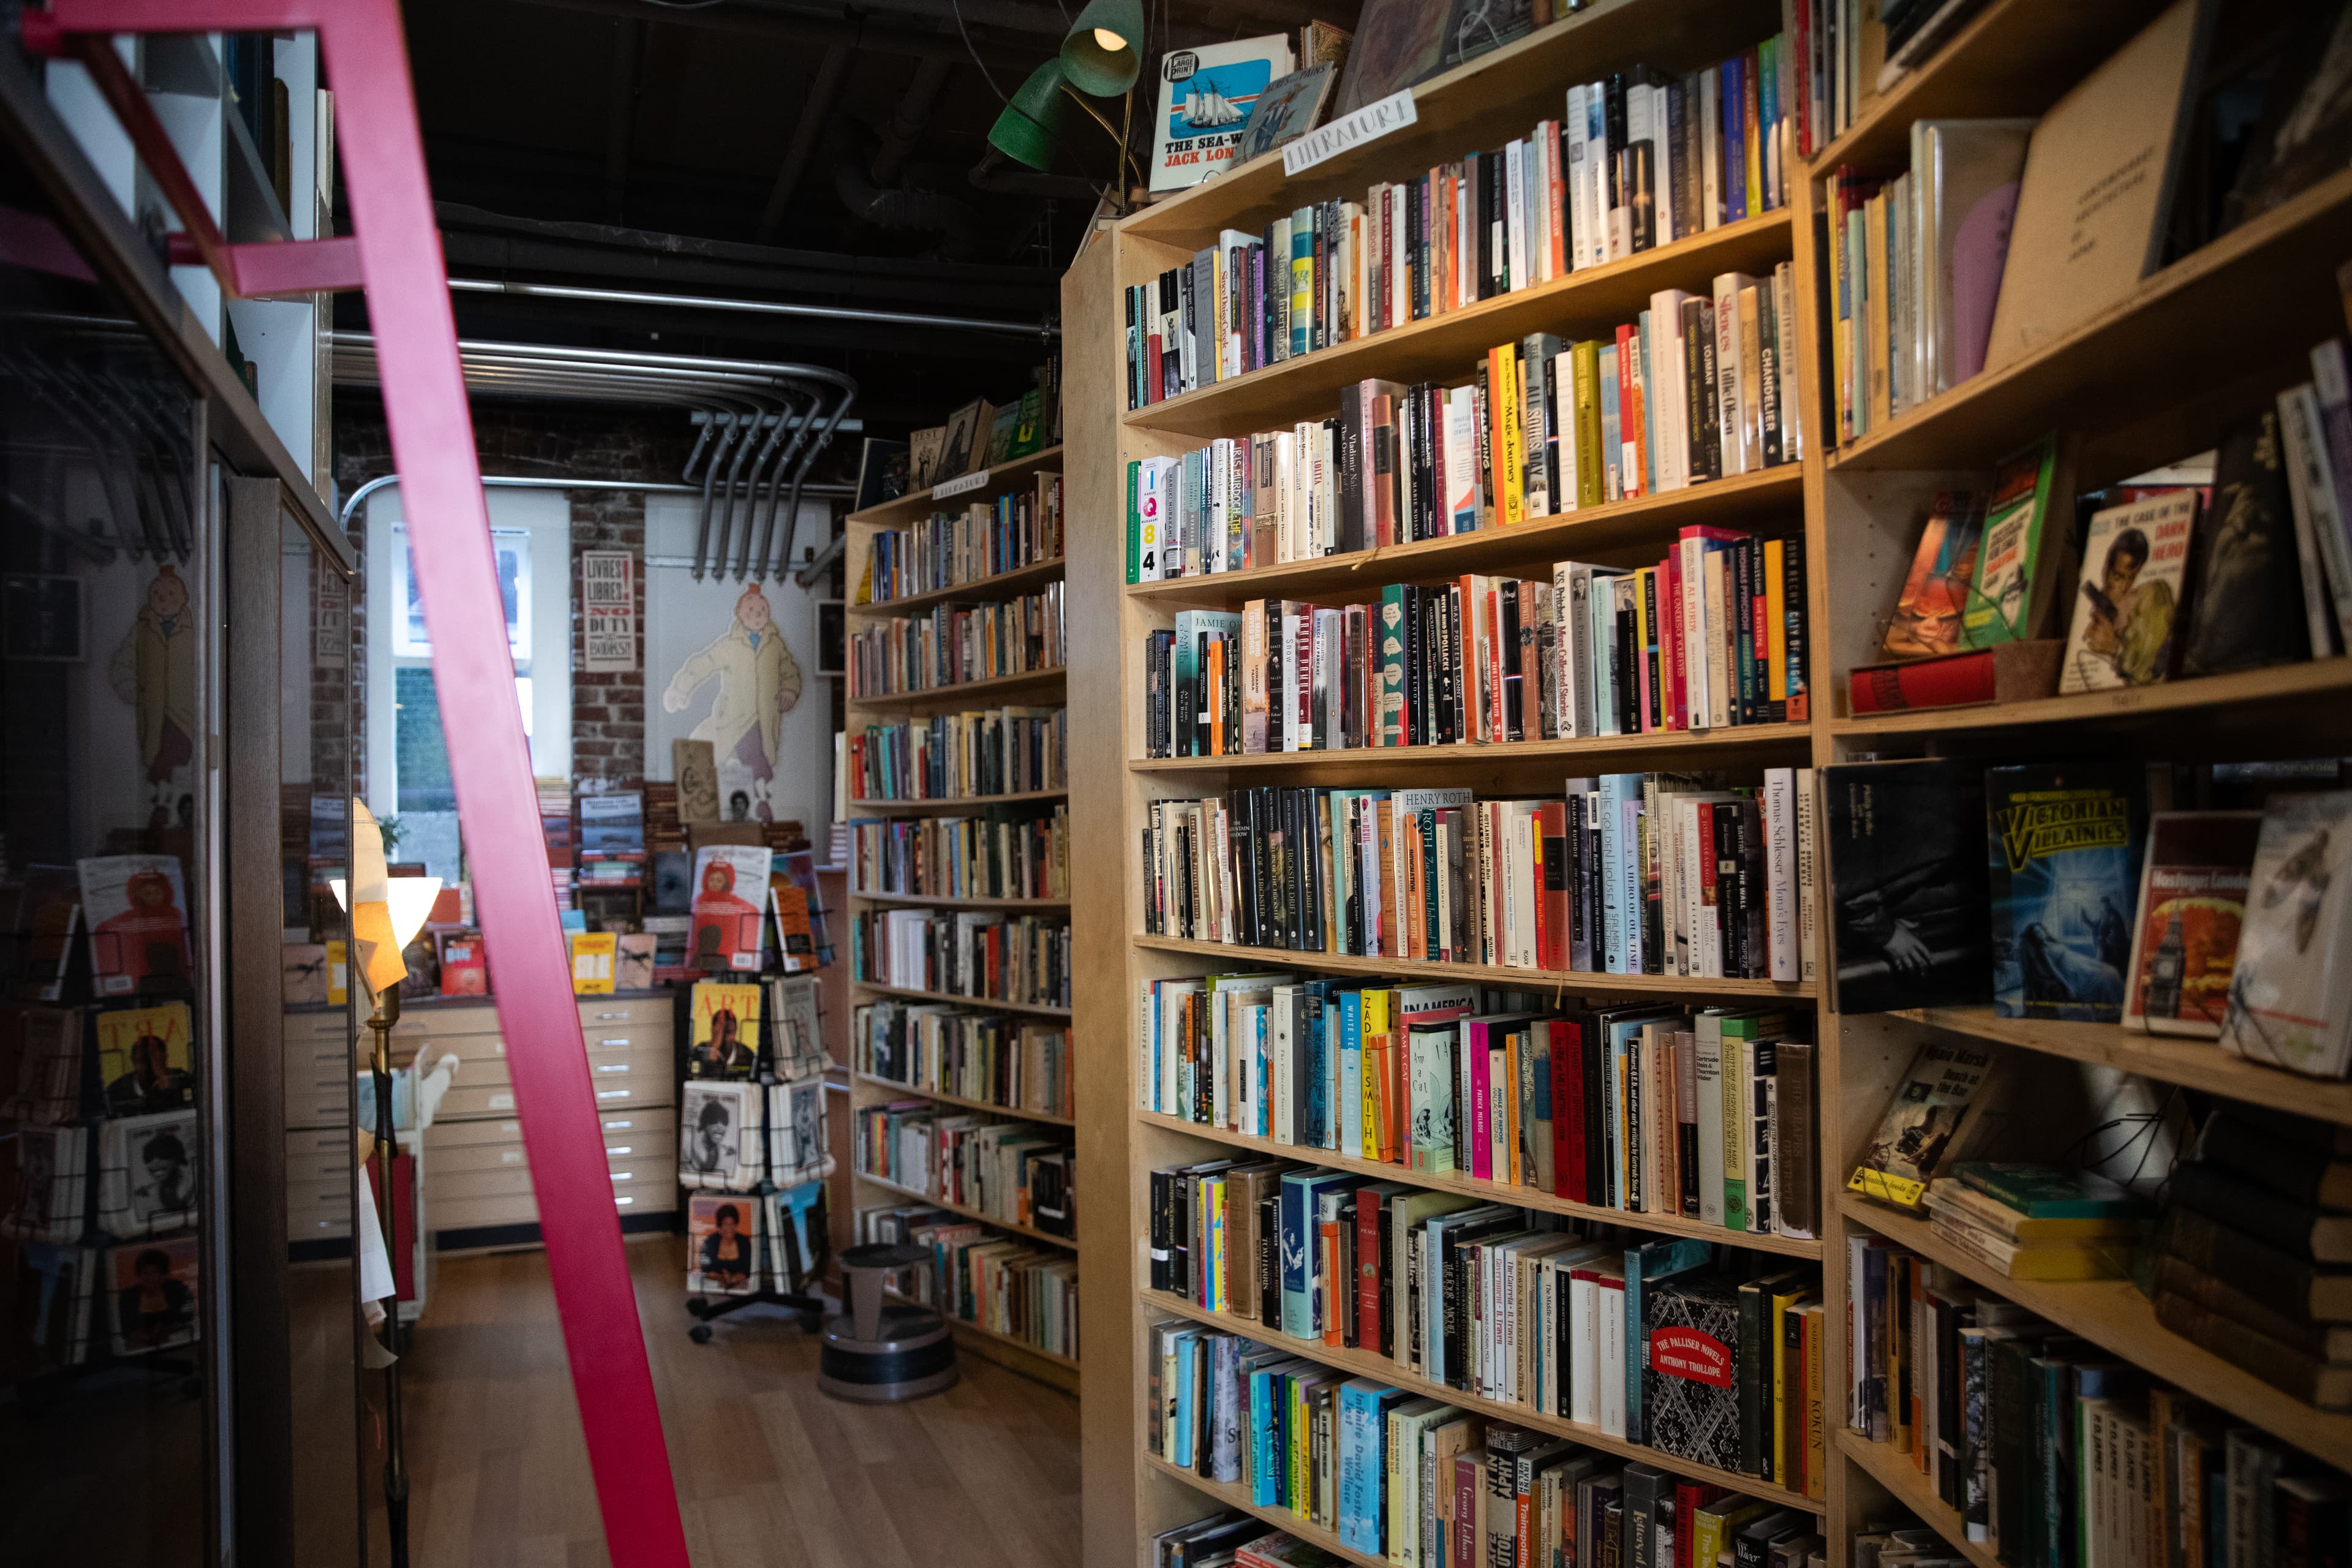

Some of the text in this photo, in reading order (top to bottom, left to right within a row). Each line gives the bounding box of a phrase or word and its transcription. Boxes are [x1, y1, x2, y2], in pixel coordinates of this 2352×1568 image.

[1171, 58, 1193, 67] LARGE
[1172, 66, 1193, 75] PRINT
[1265, 65, 1324, 92] ACRES PAINS
[1165, 132, 1243, 153] THE SEA-W
[1287, 100, 1408, 171] LITERATURE
[1165, 147, 1237, 167] JACK LON
[1278, 298, 1287, 356] Inheritance
[1717, 293, 1736, 435] Silences Tillie Olsen
[1762, 348, 1775, 431] CHANDELIER
[914, 430, 938, 441] ZEST
[1504, 405, 1515, 483] Magic Journey
[1233, 469, 1242, 514] MURDOCH
[587, 560, 621, 578] LIVRES
[1556, 588, 1566, 622] Pritchett
[1687, 586, 1694, 598] AL
[590, 618, 627, 631] DUTY
[1787, 540, 1800, 689] JOHN RECHY CITY OF NIGHT
[1559, 688, 1568, 717] Stories
[1423, 813, 1432, 846] ROTH
[1996, 797, 2128, 840] VICTORIAN
[1600, 782, 1615, 901] THE GOLDEN HOUSE
[2003, 826, 2128, 872] VILLAINIES
[1772, 779, 1787, 945] Thomas Schlesser Mona's Eyes
[1427, 902, 1436, 938] Unbound
[1629, 903, 1635, 916] OF
[698, 993, 758, 1020] ART
[1924, 1046, 1990, 1067] Ngaio Marsh
[1937, 1082, 1969, 1096] the Bar
[1943, 1068, 1980, 1085] Death at
[1498, 1110, 1503, 1118] OF
[1656, 1338, 1725, 1366] THE PALLISER NOVELS
[1660, 1354, 1721, 1378] ANTHONY TROLLOPE
[1355, 1393, 1364, 1439] Infinite
[1812, 1400, 1822, 1451] KOKUN
[1344, 1457, 1353, 1504] Wallace
[1354, 1444, 1363, 1523] David Foster
[1461, 1487, 1474, 1560] Georg Letham
